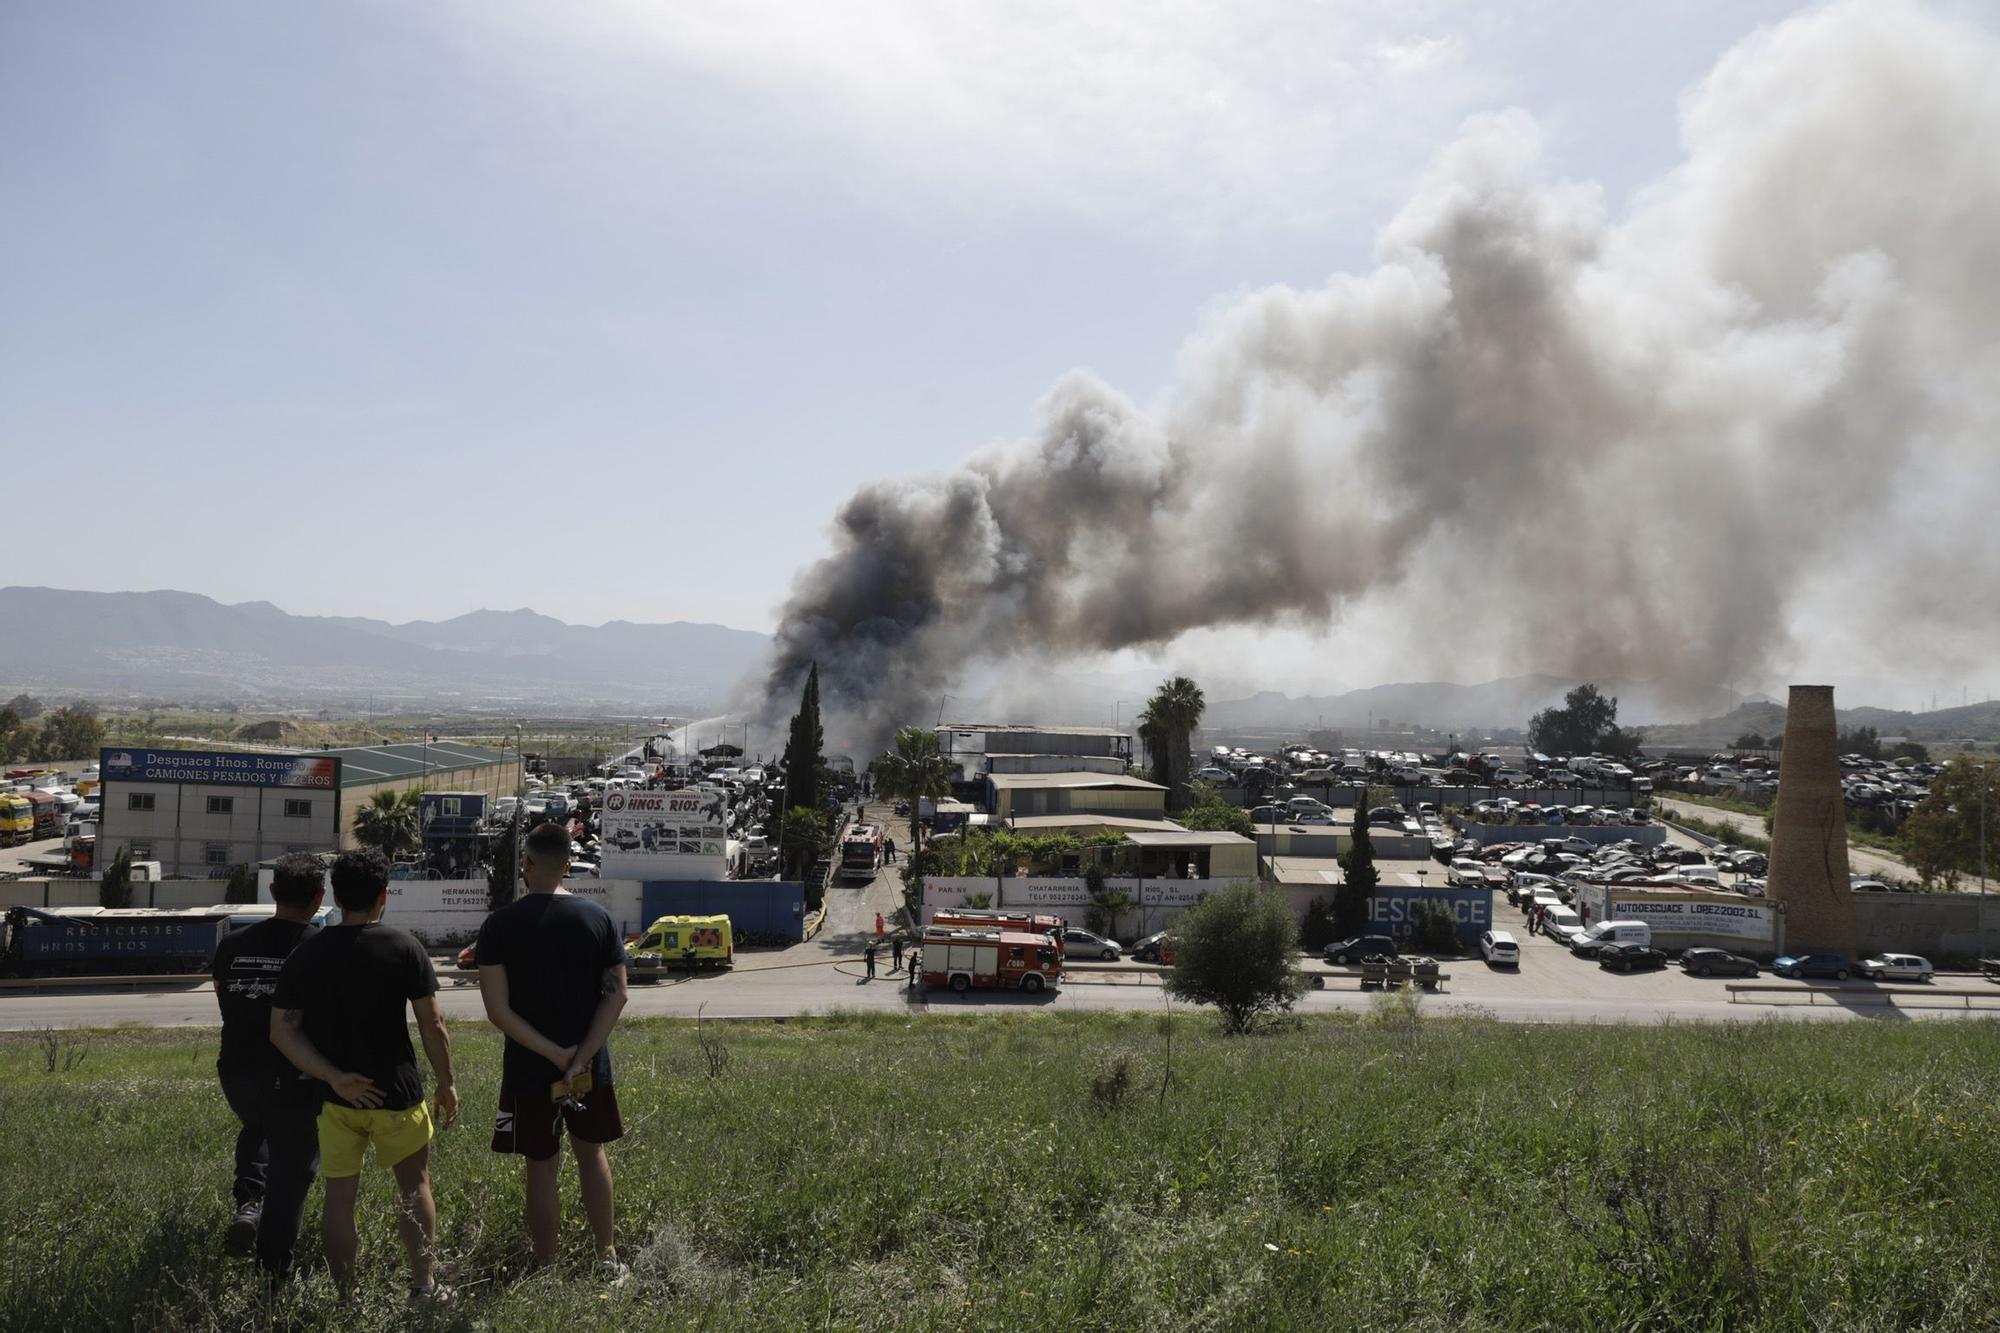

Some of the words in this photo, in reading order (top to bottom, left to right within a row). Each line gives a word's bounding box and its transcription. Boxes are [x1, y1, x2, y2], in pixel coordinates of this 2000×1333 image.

[147, 753, 211, 768] Desguace
[215, 757, 252, 769] Hnos.
[145, 768, 209, 780] CAMIONES
[213, 771, 266, 783] PESADOS
[269, 773, 277, 783] Y
[628, 799, 665, 811] HNOS.
[670, 800, 700, 812] RIOS
[66, 925, 184, 937] RECICLAJES
